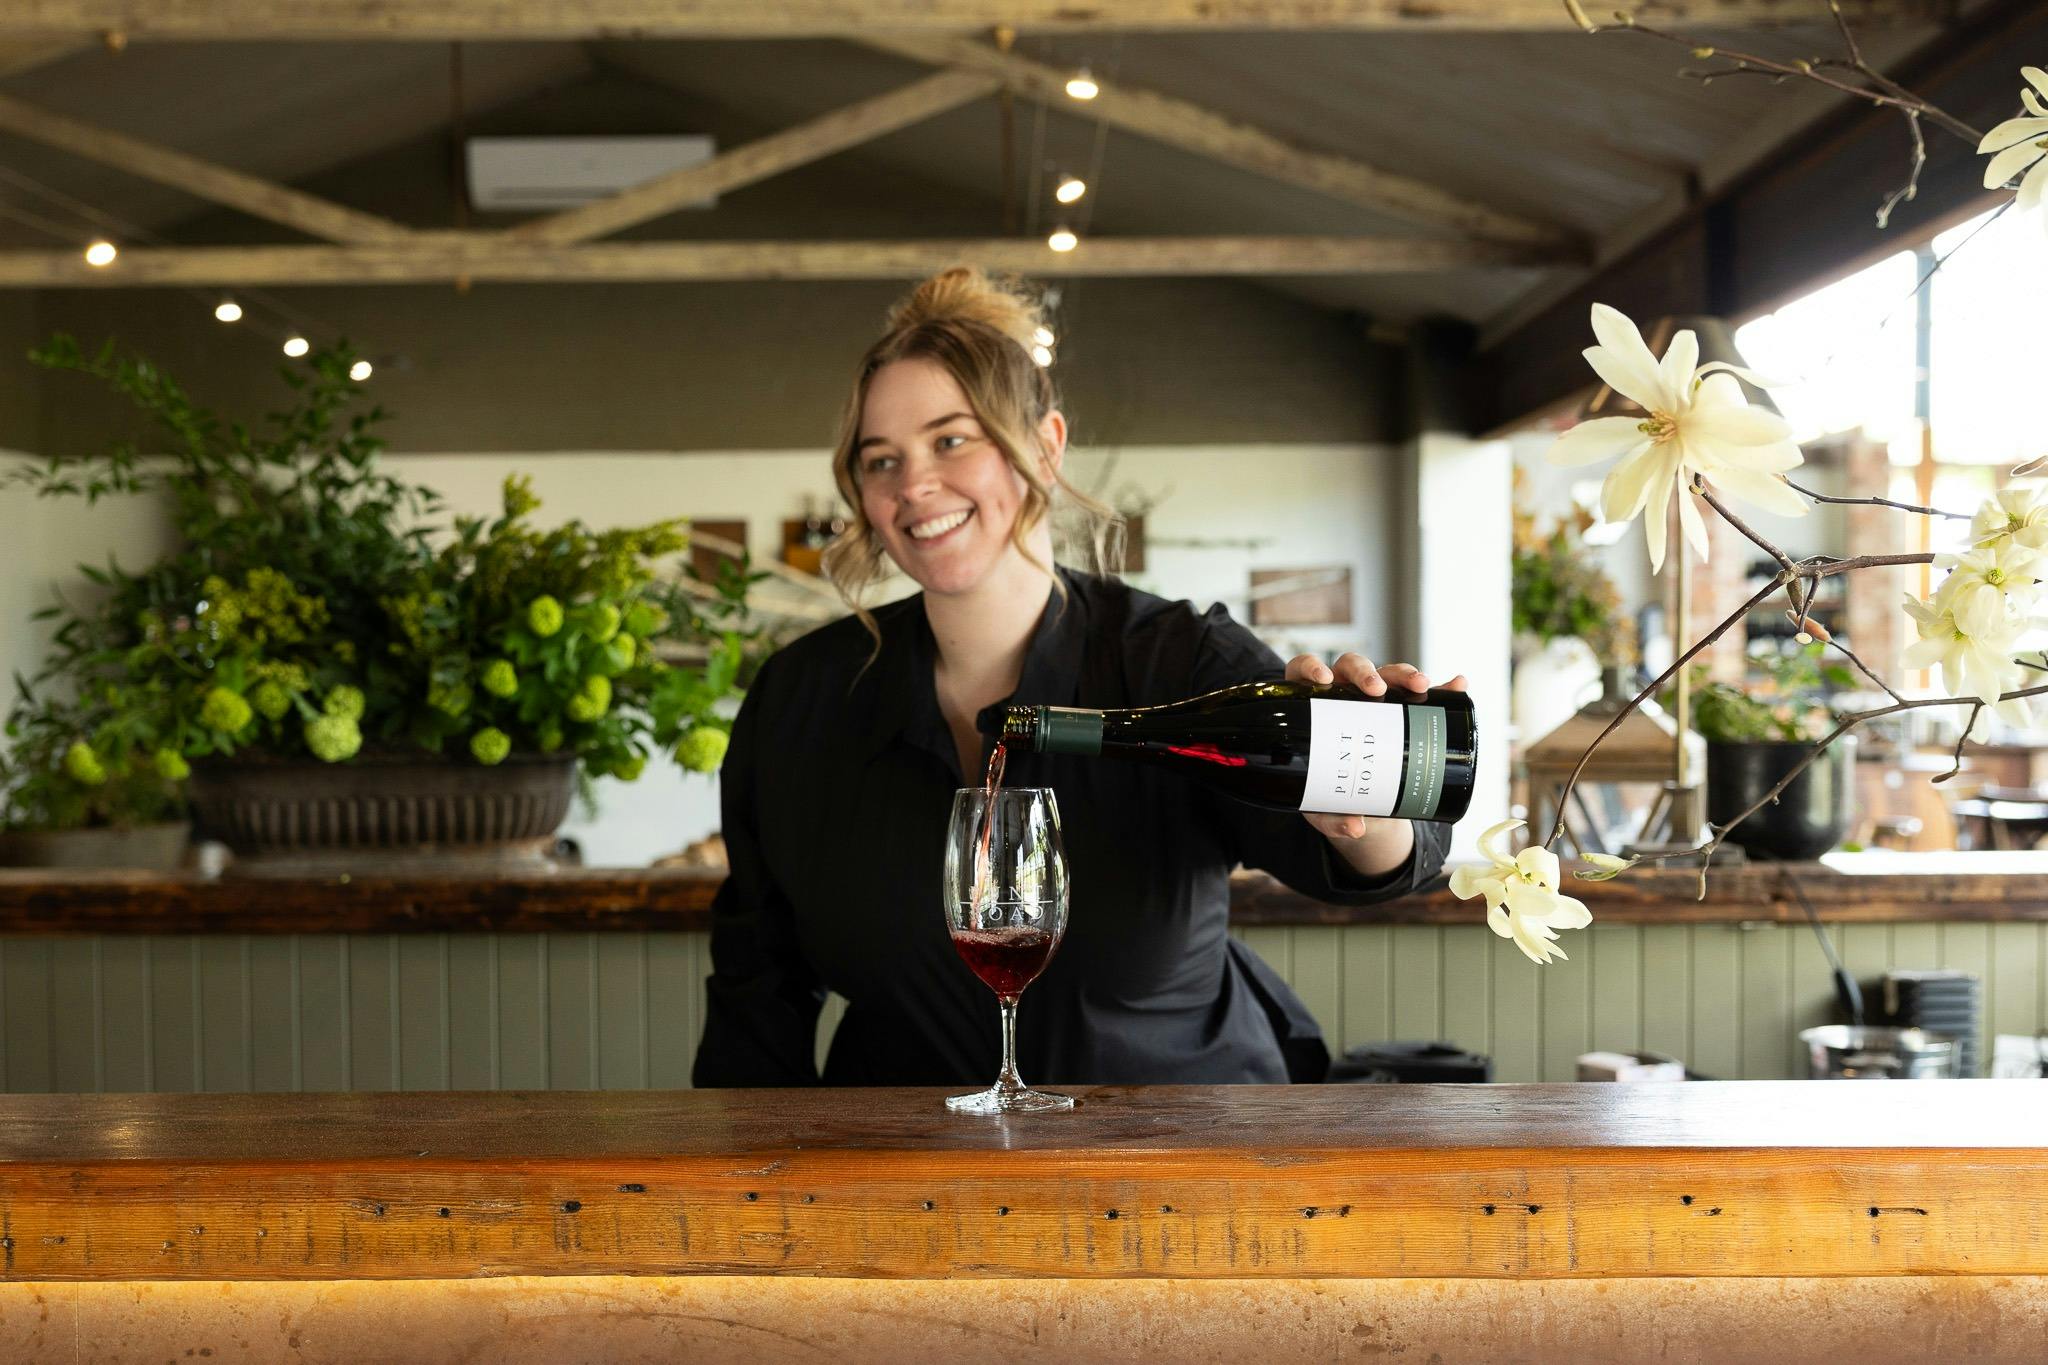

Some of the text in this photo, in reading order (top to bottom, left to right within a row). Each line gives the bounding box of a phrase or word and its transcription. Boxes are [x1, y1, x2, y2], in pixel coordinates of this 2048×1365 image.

[1335, 732, 1352, 794] PUNT
[1358, 734, 1375, 795] ROAD
[1413, 769, 1422, 796] PINOT
[969, 905, 1044, 921] OAD
